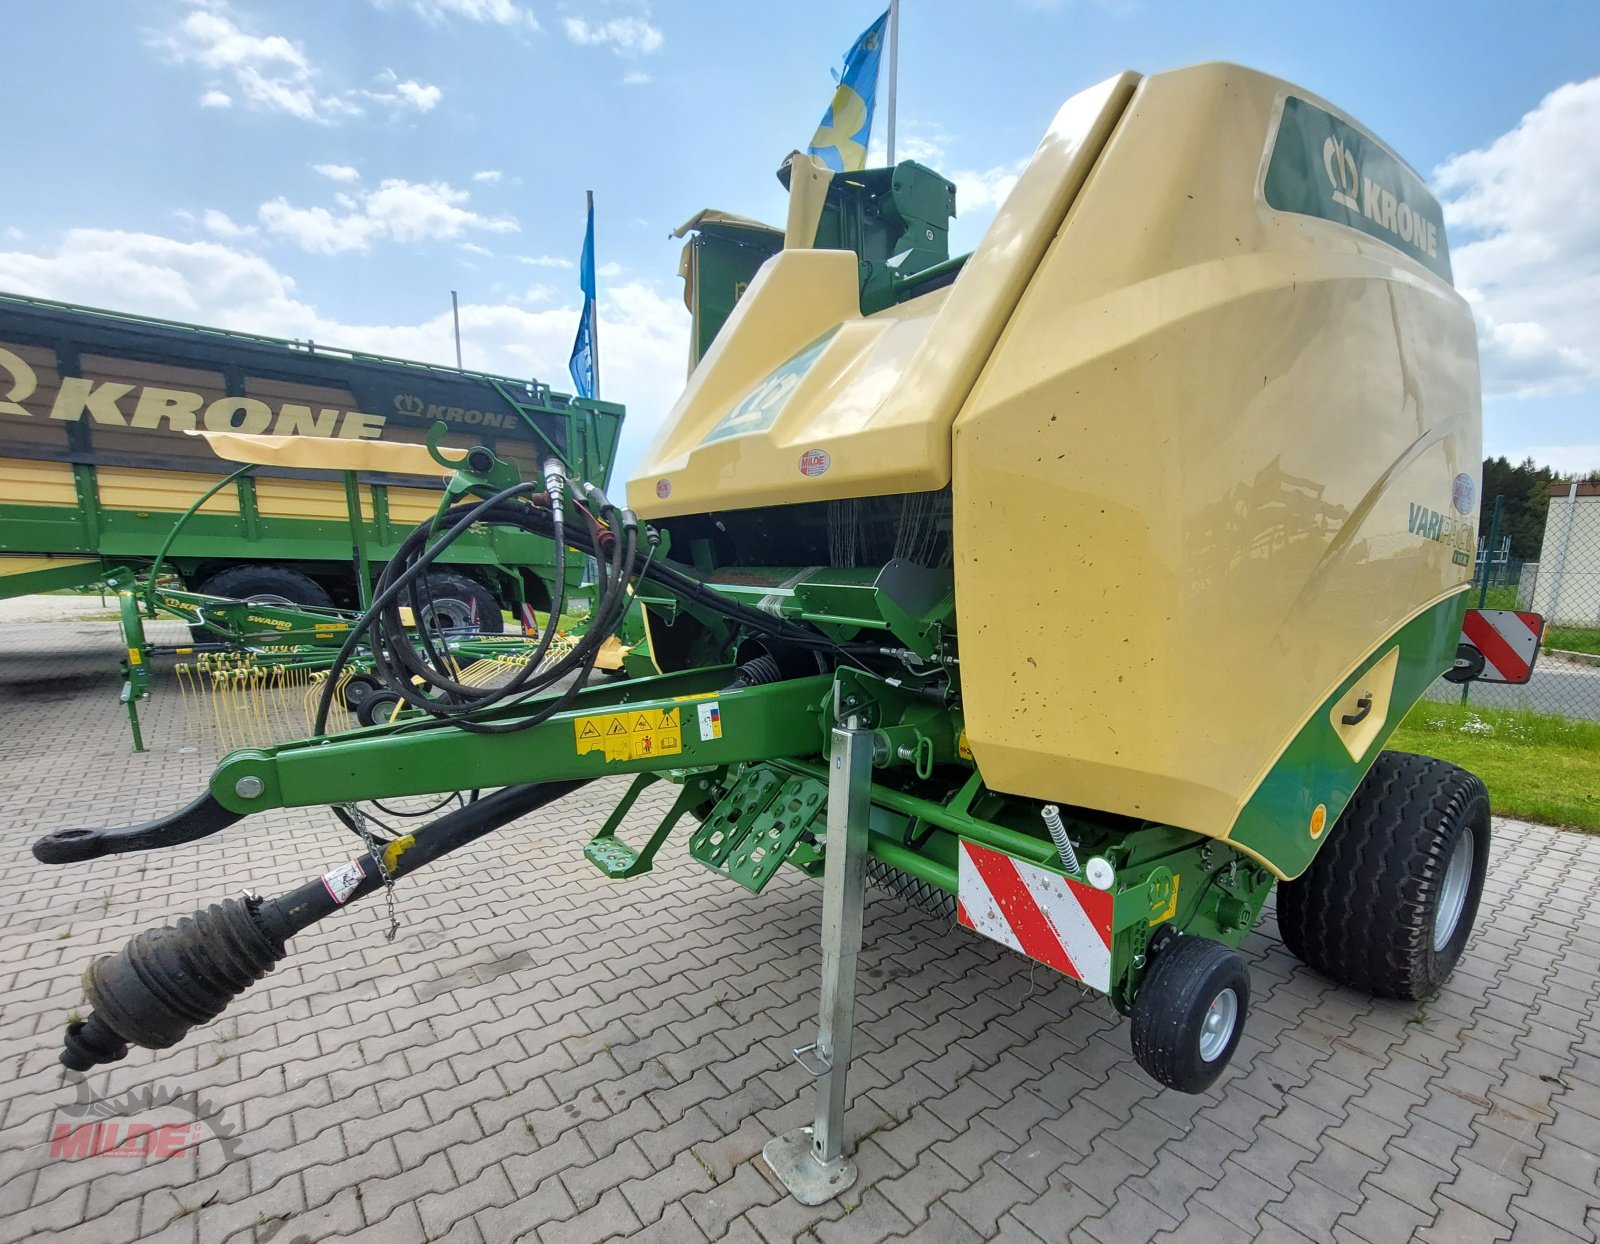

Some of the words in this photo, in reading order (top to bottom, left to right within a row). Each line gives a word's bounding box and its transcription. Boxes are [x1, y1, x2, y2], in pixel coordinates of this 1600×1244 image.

[1364, 177, 1437, 259] KRONE
[50, 376, 386, 440] KRONE
[426, 404, 518, 429] KRONE
[801, 455, 825, 468] MILDE
[247, 615, 293, 628] SWADRO
